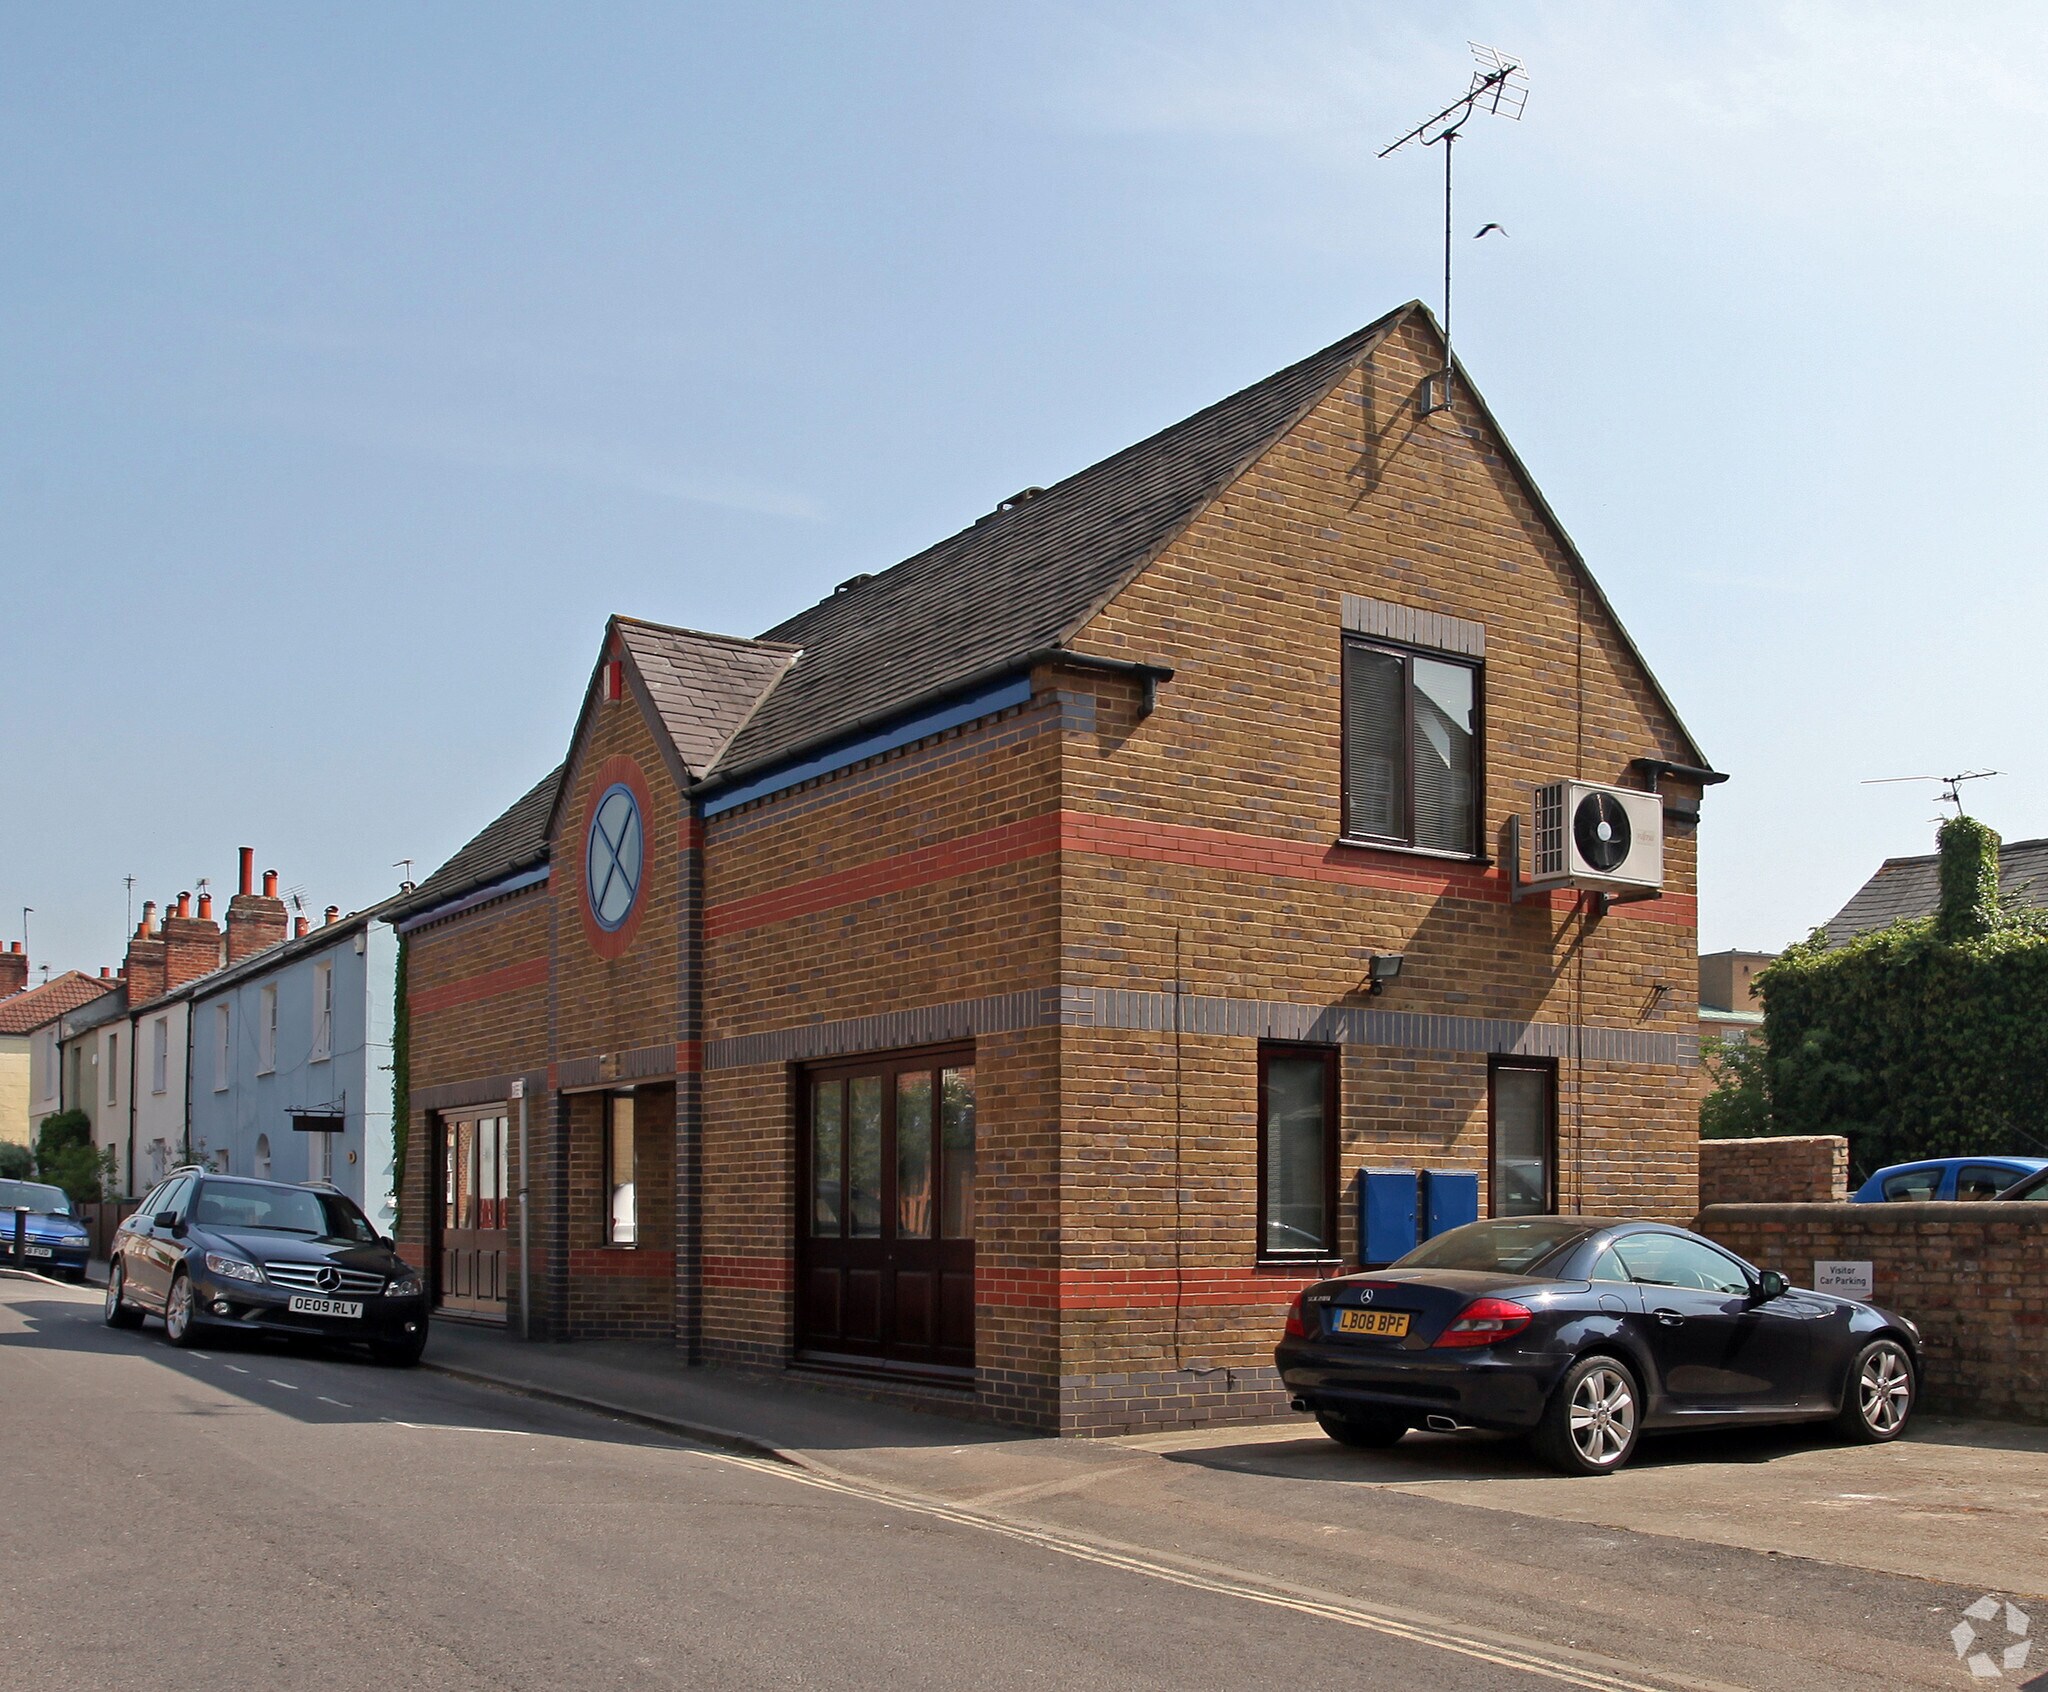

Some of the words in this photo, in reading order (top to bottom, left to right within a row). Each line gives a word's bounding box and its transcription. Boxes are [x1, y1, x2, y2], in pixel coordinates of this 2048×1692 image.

[1830, 1266, 1856, 1274] Visitor
[1820, 1276, 1833, 1285] Car
[1835, 1276, 1867, 1287] Parking
[295, 1298, 330, 1312] OE09
[332, 1302, 358, 1315] RLV
[1341, 1312, 1375, 1330] LB08
[1378, 1314, 1405, 1332] BPF
